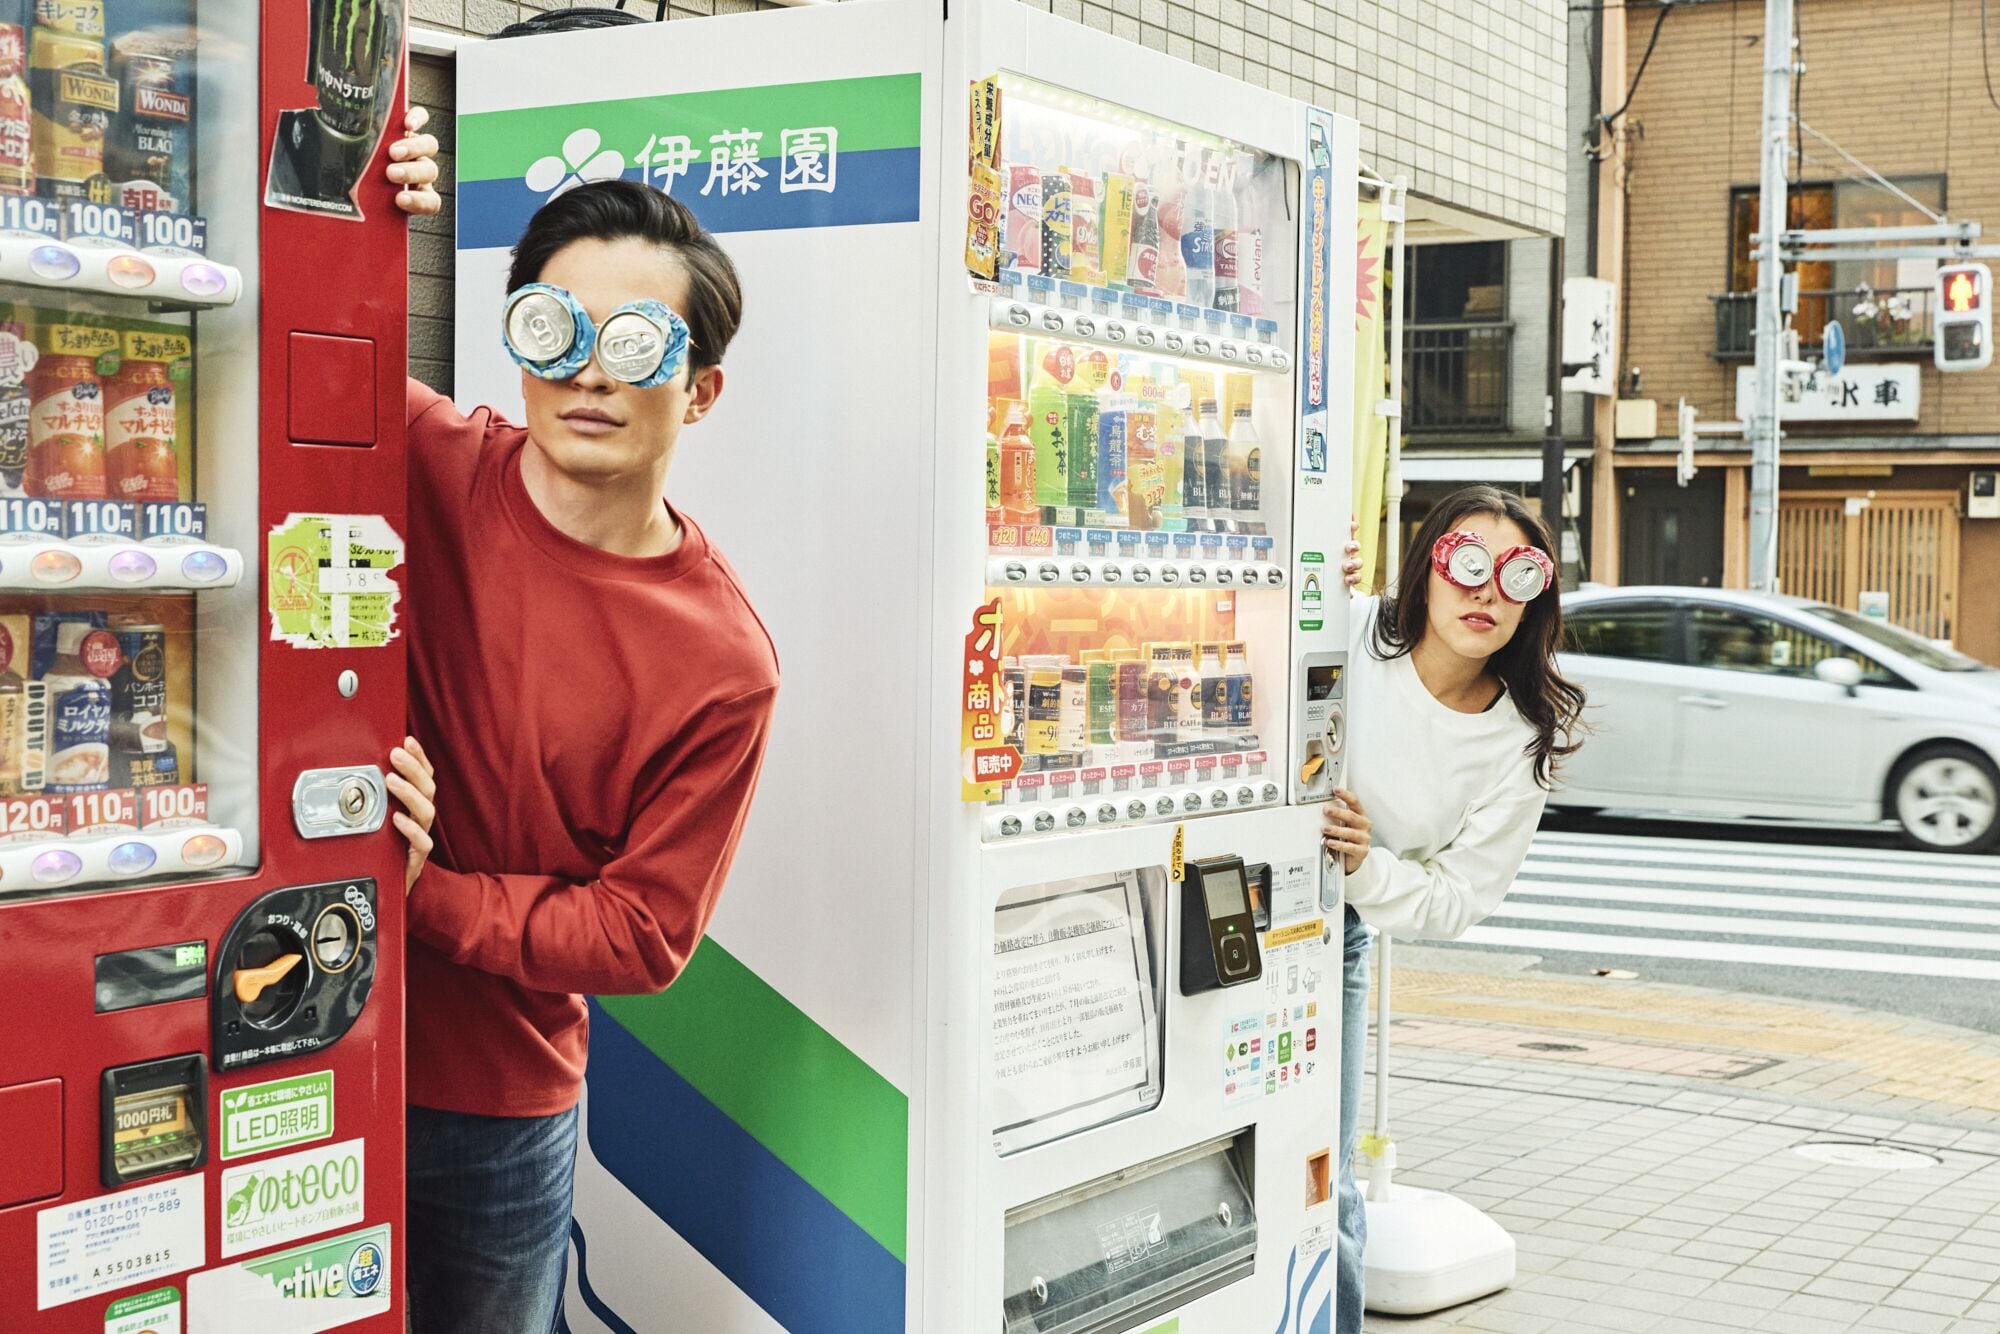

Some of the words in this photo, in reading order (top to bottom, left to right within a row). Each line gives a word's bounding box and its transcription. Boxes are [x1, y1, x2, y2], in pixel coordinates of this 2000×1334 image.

[68, 76, 116, 101] WONDA
[139, 90, 187, 115] WONDA
[633, 126, 838, 197] 伊藤園
[969, 192, 1000, 226] GO!
[1016, 193, 1040, 206] NEC
[70, 203, 133, 239] 100円
[143, 213, 203, 249] 100円
[1254, 238, 1263, 282] evian
[0, 500, 60, 531] 110円
[72, 501, 132, 533] 110円
[146, 504, 203, 534] 110円
[967, 681, 994, 740] 商品
[976, 753, 1013, 776] 販売中
[0, 799, 62, 834] 120円
[72, 795, 133, 826] 110円
[146, 787, 206, 819] 100円
[247, 1081, 328, 1108] 省エネで環境にやさしい
[117, 1105, 172, 1129] 1000円札
[235, 1103, 320, 1144] LED照明
[258, 1154, 359, 1214] のむeco
[84, 1198, 181, 1232] 0120-017-889
[92, 1268, 101, 1279] A
[106, 1248, 171, 1275] 5503815
[262, 1256, 345, 1300] ctive
[352, 1265, 380, 1282] 省エネ
